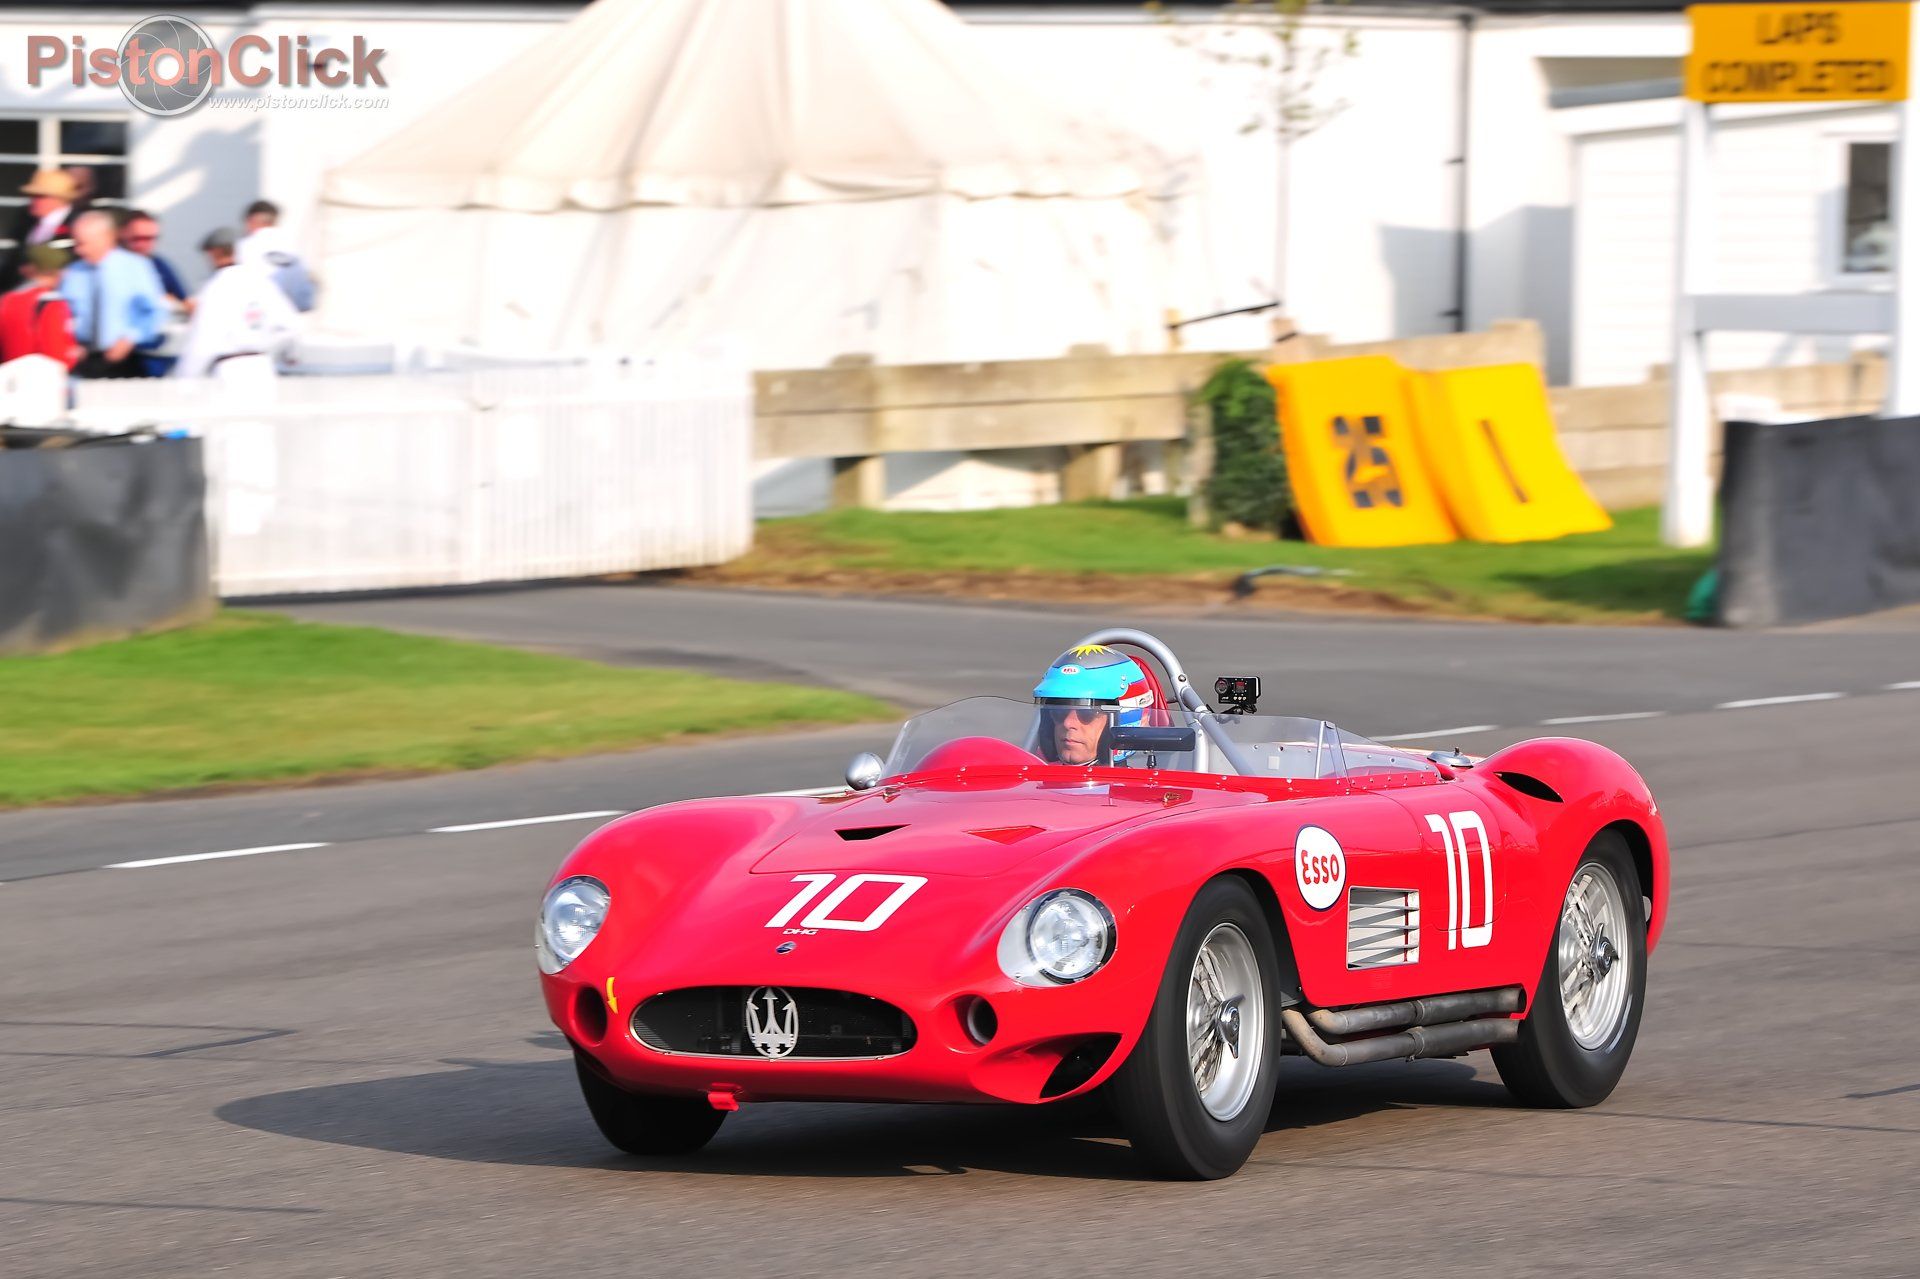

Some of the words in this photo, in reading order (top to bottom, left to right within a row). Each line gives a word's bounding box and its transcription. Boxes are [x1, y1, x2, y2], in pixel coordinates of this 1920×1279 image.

[1755, 12, 1841, 44] LAPS
[1703, 60, 1894, 94] COMPLETED
[1301, 849, 1340, 885] Esso
[1424, 810, 1494, 951] 10
[764, 873, 929, 932] 10
[782, 928, 819, 936] DHG
